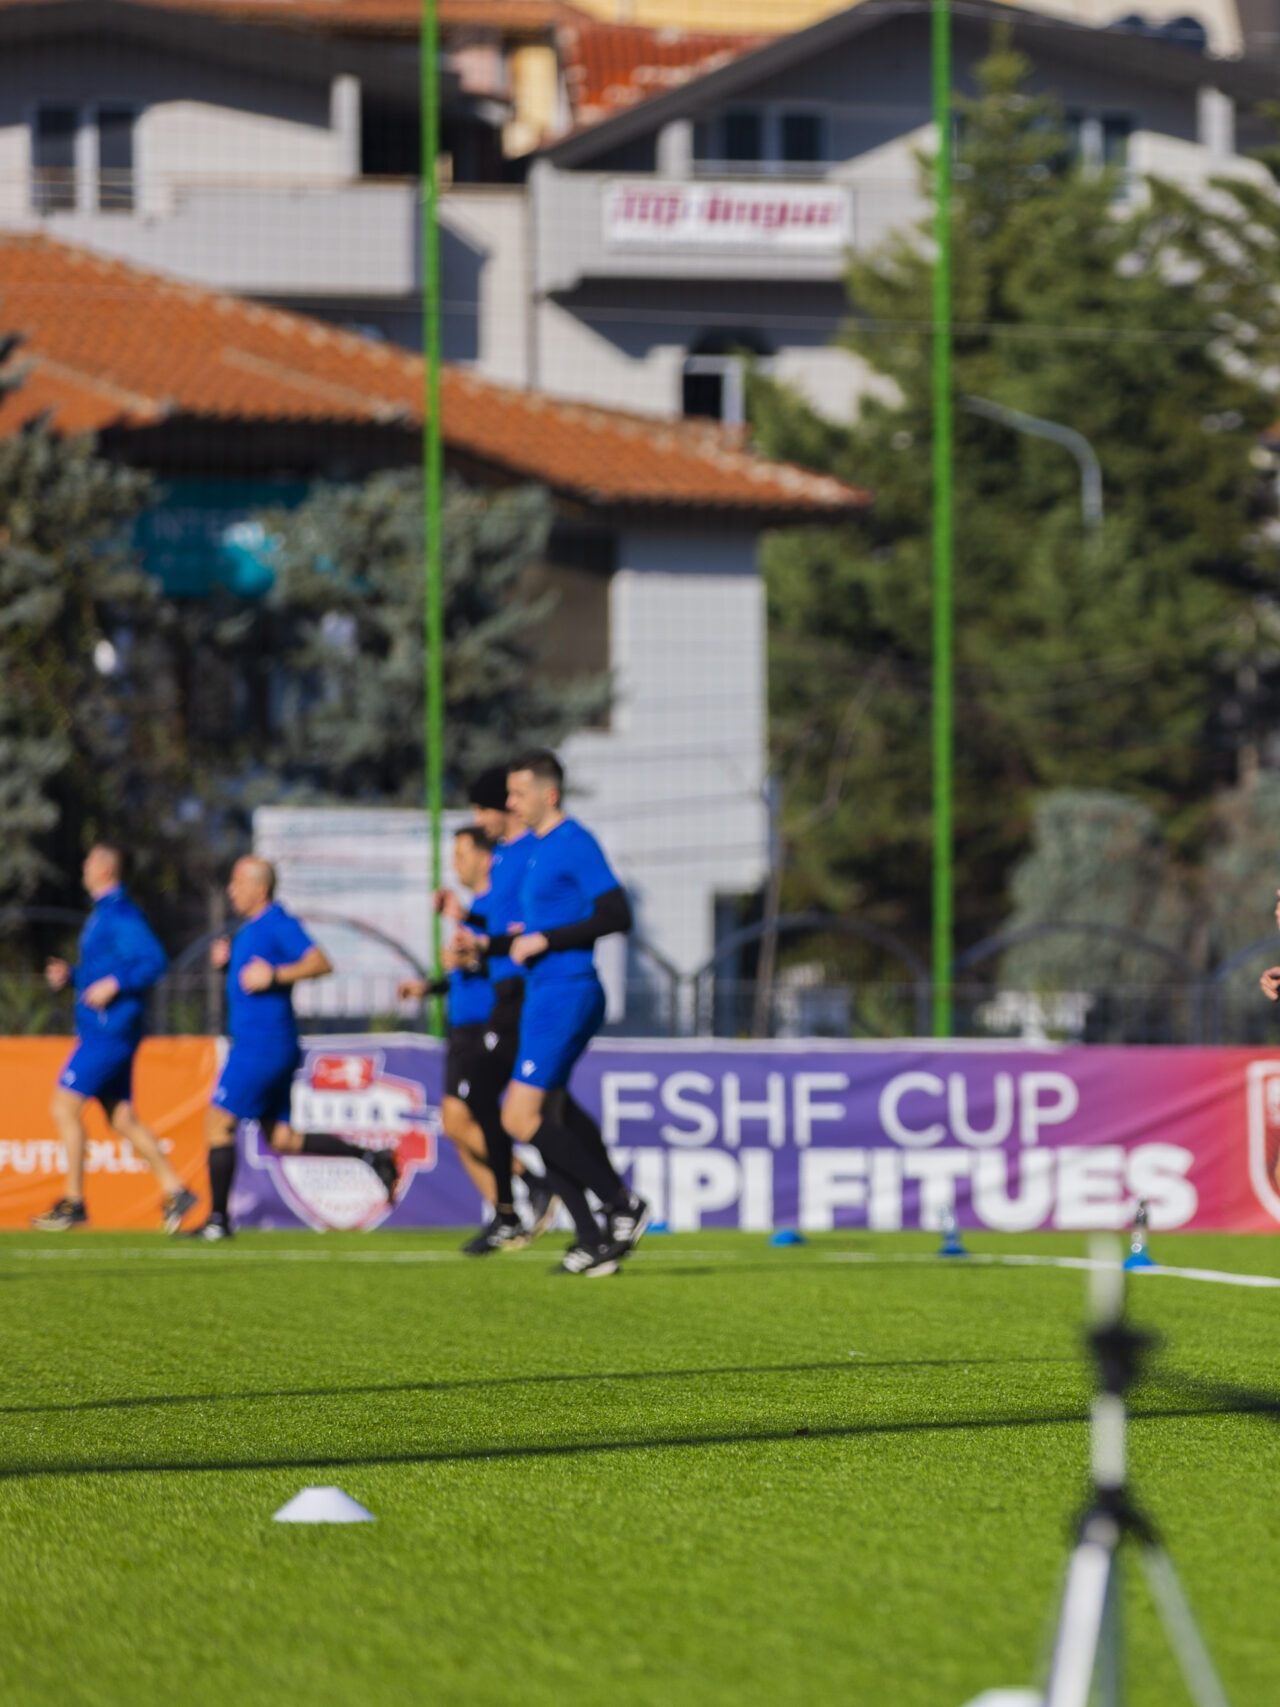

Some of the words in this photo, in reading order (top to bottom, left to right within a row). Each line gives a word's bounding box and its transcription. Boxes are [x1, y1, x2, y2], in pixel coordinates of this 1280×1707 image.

[601, 1071, 850, 1147] FSHF
[878, 1071, 1079, 1148] CUP
[801, 1142, 1199, 1233] FITUES
